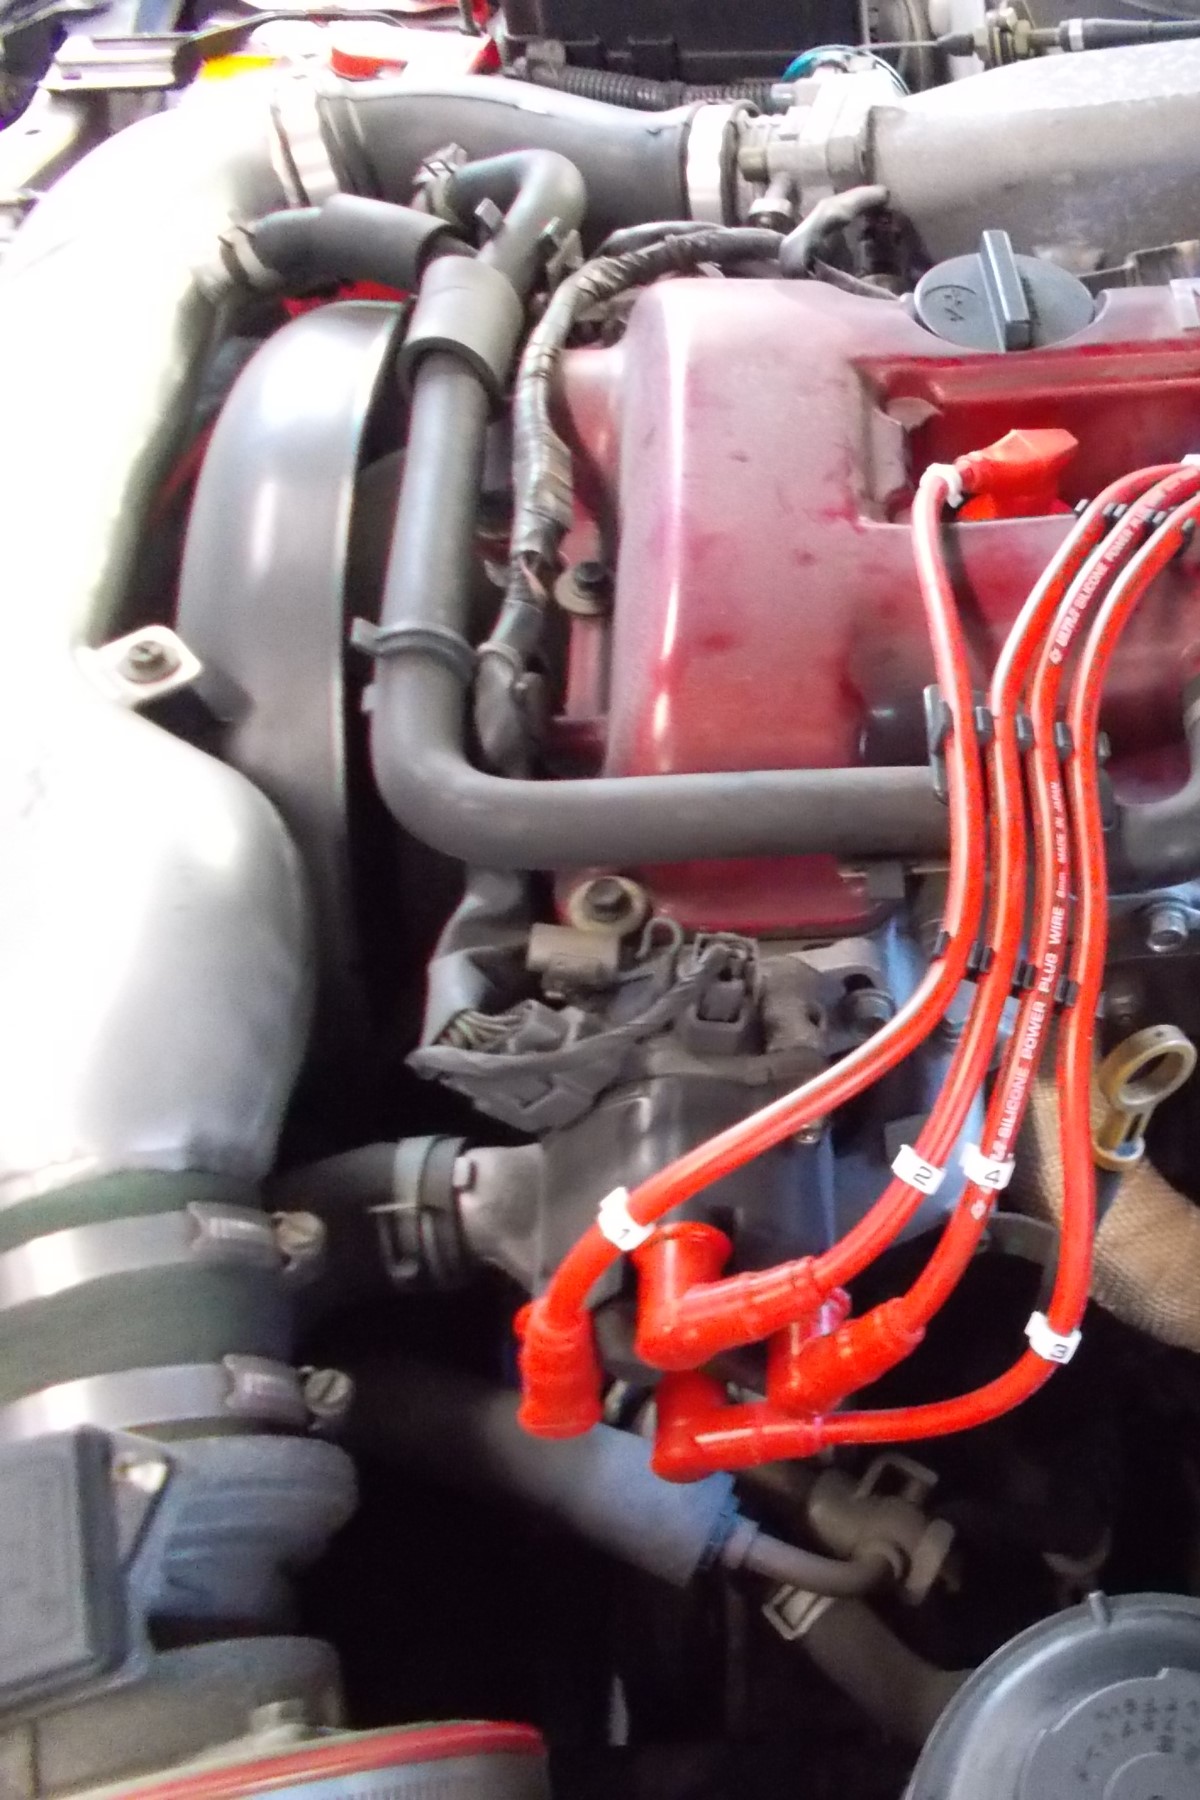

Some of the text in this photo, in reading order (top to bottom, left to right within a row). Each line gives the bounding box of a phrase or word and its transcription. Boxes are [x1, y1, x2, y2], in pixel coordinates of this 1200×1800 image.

[1048, 905, 1066, 946] WIRE
[1038, 952, 1059, 992] PLUG
[1021, 1000, 1047, 1060] POWER
[998, 1066, 1030, 1138] SILICONE
[912, 1165, 934, 1187] 2
[984, 1168, 1002, 1186] 4
[1050, 1343, 1069, 1360] 3
